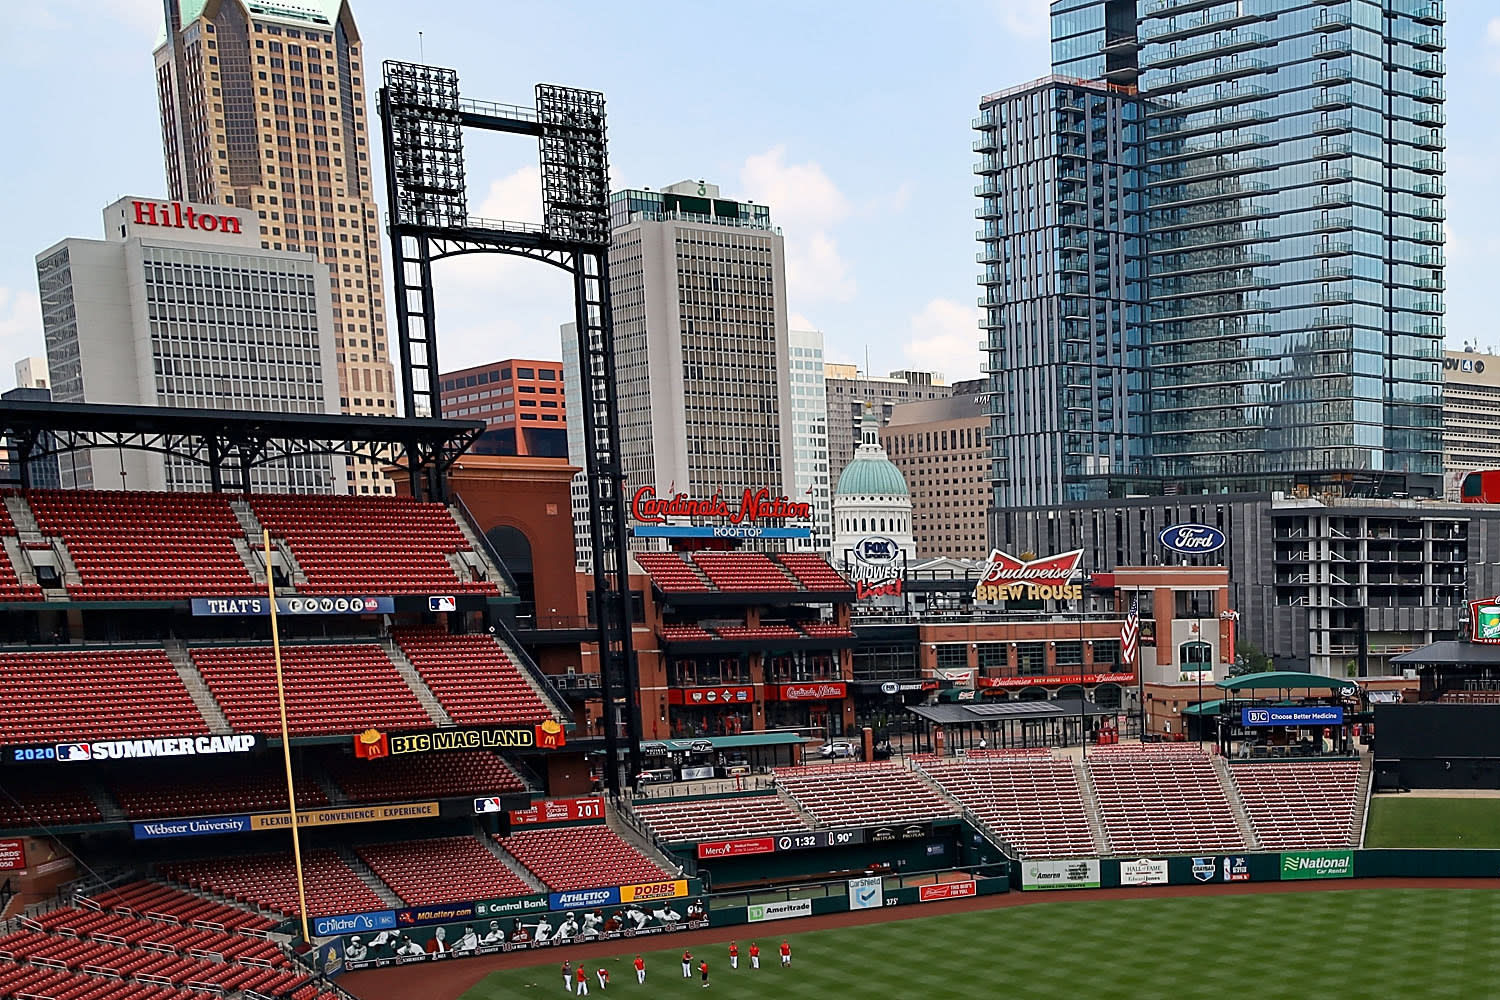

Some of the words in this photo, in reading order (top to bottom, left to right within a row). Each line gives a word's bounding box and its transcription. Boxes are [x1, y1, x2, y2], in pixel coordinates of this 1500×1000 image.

[132, 201, 242, 234] Hilton
[632, 486, 730, 523] Cardinals
[730, 488, 810, 524] Nation
[713, 527, 762, 537] ROOFTOP
[1174, 528, 1213, 548] Ford
[864, 541, 891, 553] FOX
[851, 566, 905, 579] MIDWEST
[856, 578, 902, 600] Live!
[976, 585, 1024, 600] BREW
[1028, 584, 1083, 600] HOUSE
[207, 599, 261, 613] THAT'S
[991, 677, 1032, 687] Budweiser
[1095, 673, 1134, 683] Budweiser
[787, 687, 815, 698] Cardinals
[817, 685, 841, 696] Nation
[1251, 713, 1267, 721] BJC
[14, 748, 55, 760] 2020
[93, 737, 196, 759] SUMMER
[195, 734, 256, 754] CAMP
[391, 735, 431, 755] BIG
[433, 731, 479, 750] MAC
[482, 729, 533, 747] LAND
[319, 809, 375, 823] CONVENIENCE
[384, 805, 432, 817] EXPERIENCE
[577, 804, 599, 817] 201
[144, 822, 187, 835] Webster
[189, 819, 244, 834] University
[795, 837, 815, 847] 1:32
[837, 832, 853, 842] 90°
[705, 847, 726, 855] Mercy
[1299, 856, 1350, 869] National
[634, 882, 675, 896] DOBBS
[849, 877, 881, 888] CarShield
[559, 891, 610, 903] ATHLETICO
[490, 901, 522, 913] Central
[524, 898, 548, 910] Bank
[752, 907, 762, 917] TD
[766, 903, 810, 914] Ameritrade
[417, 908, 472, 921] MOLottery.com
[318, 915, 373, 934] Children's
